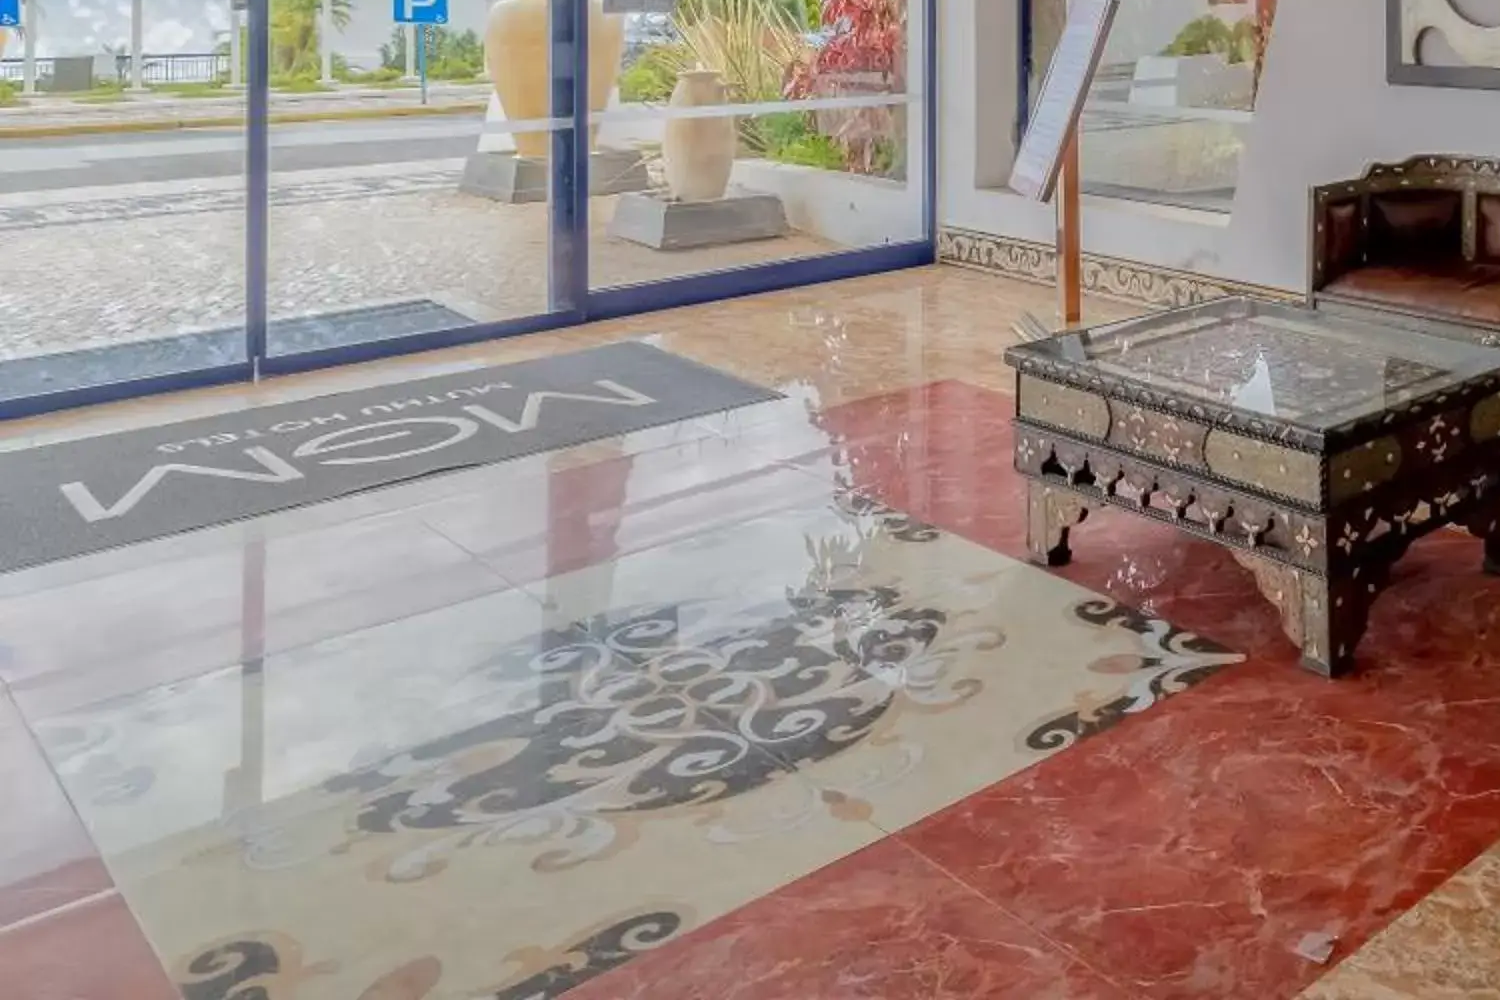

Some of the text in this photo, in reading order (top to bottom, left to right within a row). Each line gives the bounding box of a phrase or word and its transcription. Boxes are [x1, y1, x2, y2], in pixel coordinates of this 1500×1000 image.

[60, 379, 658, 522] MGM
[156, 381, 513, 454] MUTHU HOTELS
